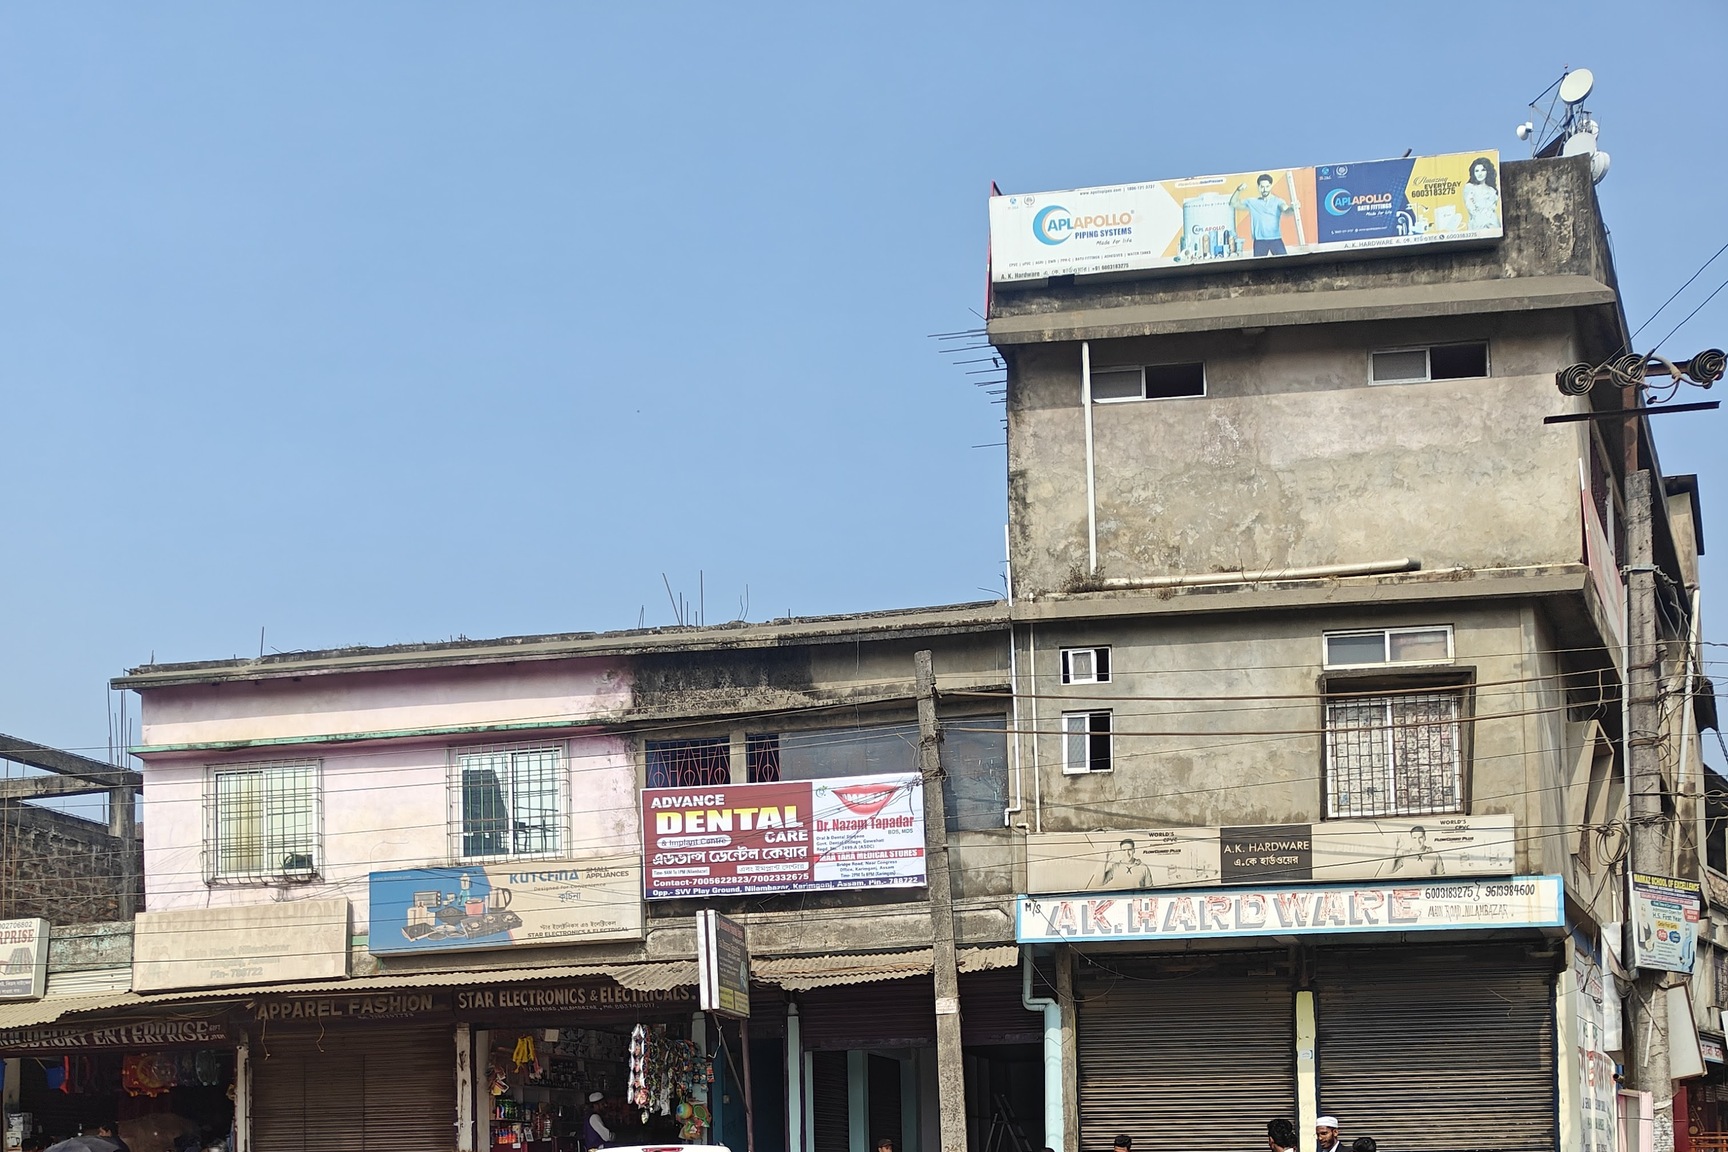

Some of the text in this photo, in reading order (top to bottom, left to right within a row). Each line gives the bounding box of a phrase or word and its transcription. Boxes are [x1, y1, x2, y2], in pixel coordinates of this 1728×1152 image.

[1411, 187, 1456, 198] 6003183275
[1424, 181, 1461, 190] EVERYDAY
[1075, 227, 1132, 239] PIPING SYSTEMS
[1359, 239, 1393, 247] HARDWARE
[1014, 271, 1040, 279] Hardware
[651, 794, 725, 809] ADVANCE
[656, 805, 804, 834] DENTAL
[816, 820, 830, 832] Dr.
[869, 816, 914, 830] Tapadar
[669, 838, 698, 848] Implant
[764, 829, 809, 843] CARE
[856, 851, 888, 860] MEDICAL
[889, 848, 917, 858] STORES
[1223, 841, 1310, 854] A.K. HARDWARE
[586, 870, 629, 879] APPLIANCES
[693, 887, 710, 896] Play
[712, 886, 742, 894] Ground,
[888, 876, 918, 884] 788722
[1652, 876, 1667, 887] SCHOOL
[1667, 879, 1674, 888] OF
[1674, 880, 1700, 892] EXCELLENCE
[1425, 884, 1535, 899] 6003183275 9613984600
[1025, 900, 1041, 917] M/S
[545, 929, 585, 937] ELECTRONICS
[458, 990, 494, 1009] STAR
[499, 988, 586, 1007] ELECTRONICS
[589, 990, 598, 1002] &
[257, 995, 433, 1020] APPAREL FASHION
[93, 1021, 210, 1046] ENTERPRISE
